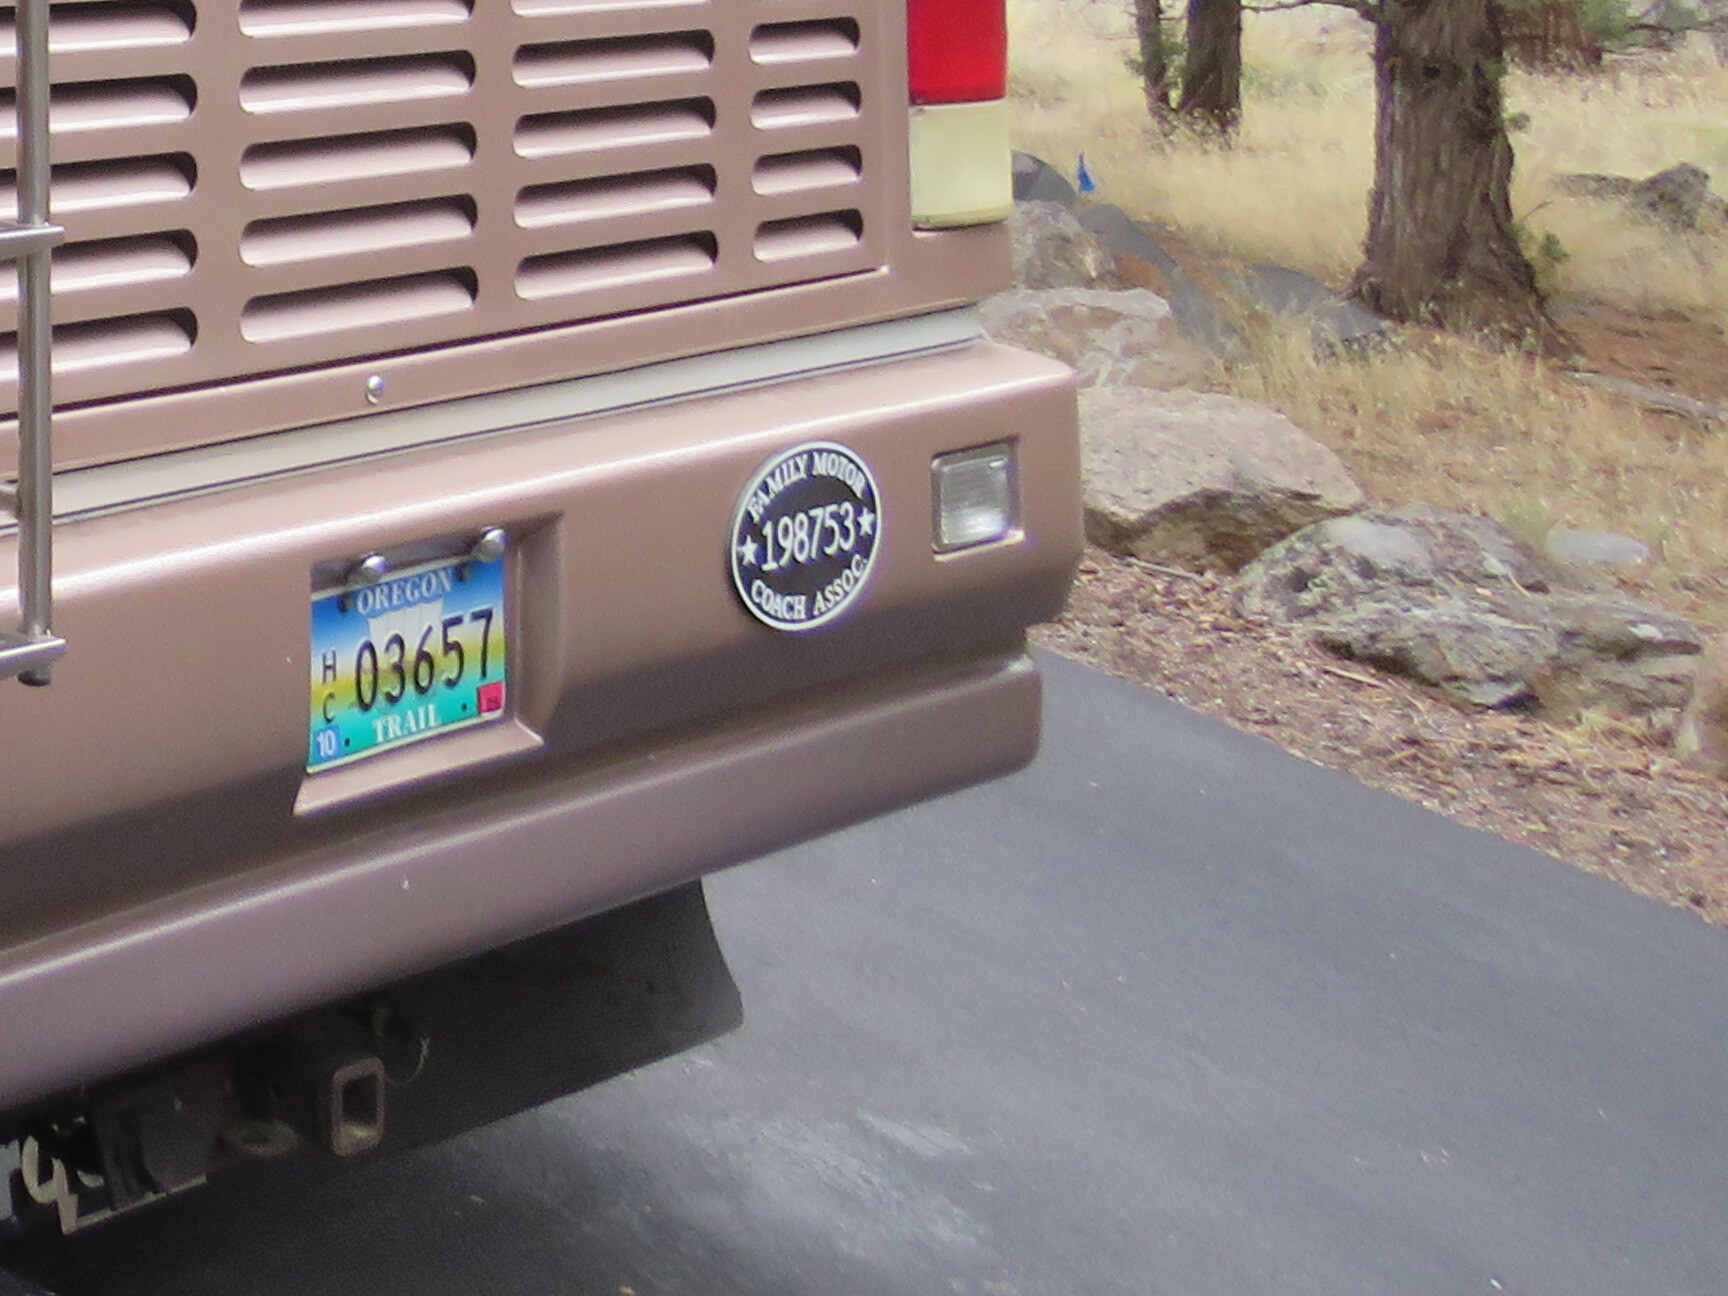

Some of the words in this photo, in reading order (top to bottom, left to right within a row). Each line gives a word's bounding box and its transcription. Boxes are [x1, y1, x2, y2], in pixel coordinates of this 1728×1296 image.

[747, 454, 808, 524] FAMILY
[812, 451, 866, 500] MOTOR
[760, 501, 855, 572] 198753
[356, 567, 453, 614] OREGON
[751, 578, 806, 621] COACH
[355, 608, 493, 712] 03657
[316, 730, 340, 758] 10
[372, 704, 441, 743] TRAIL
